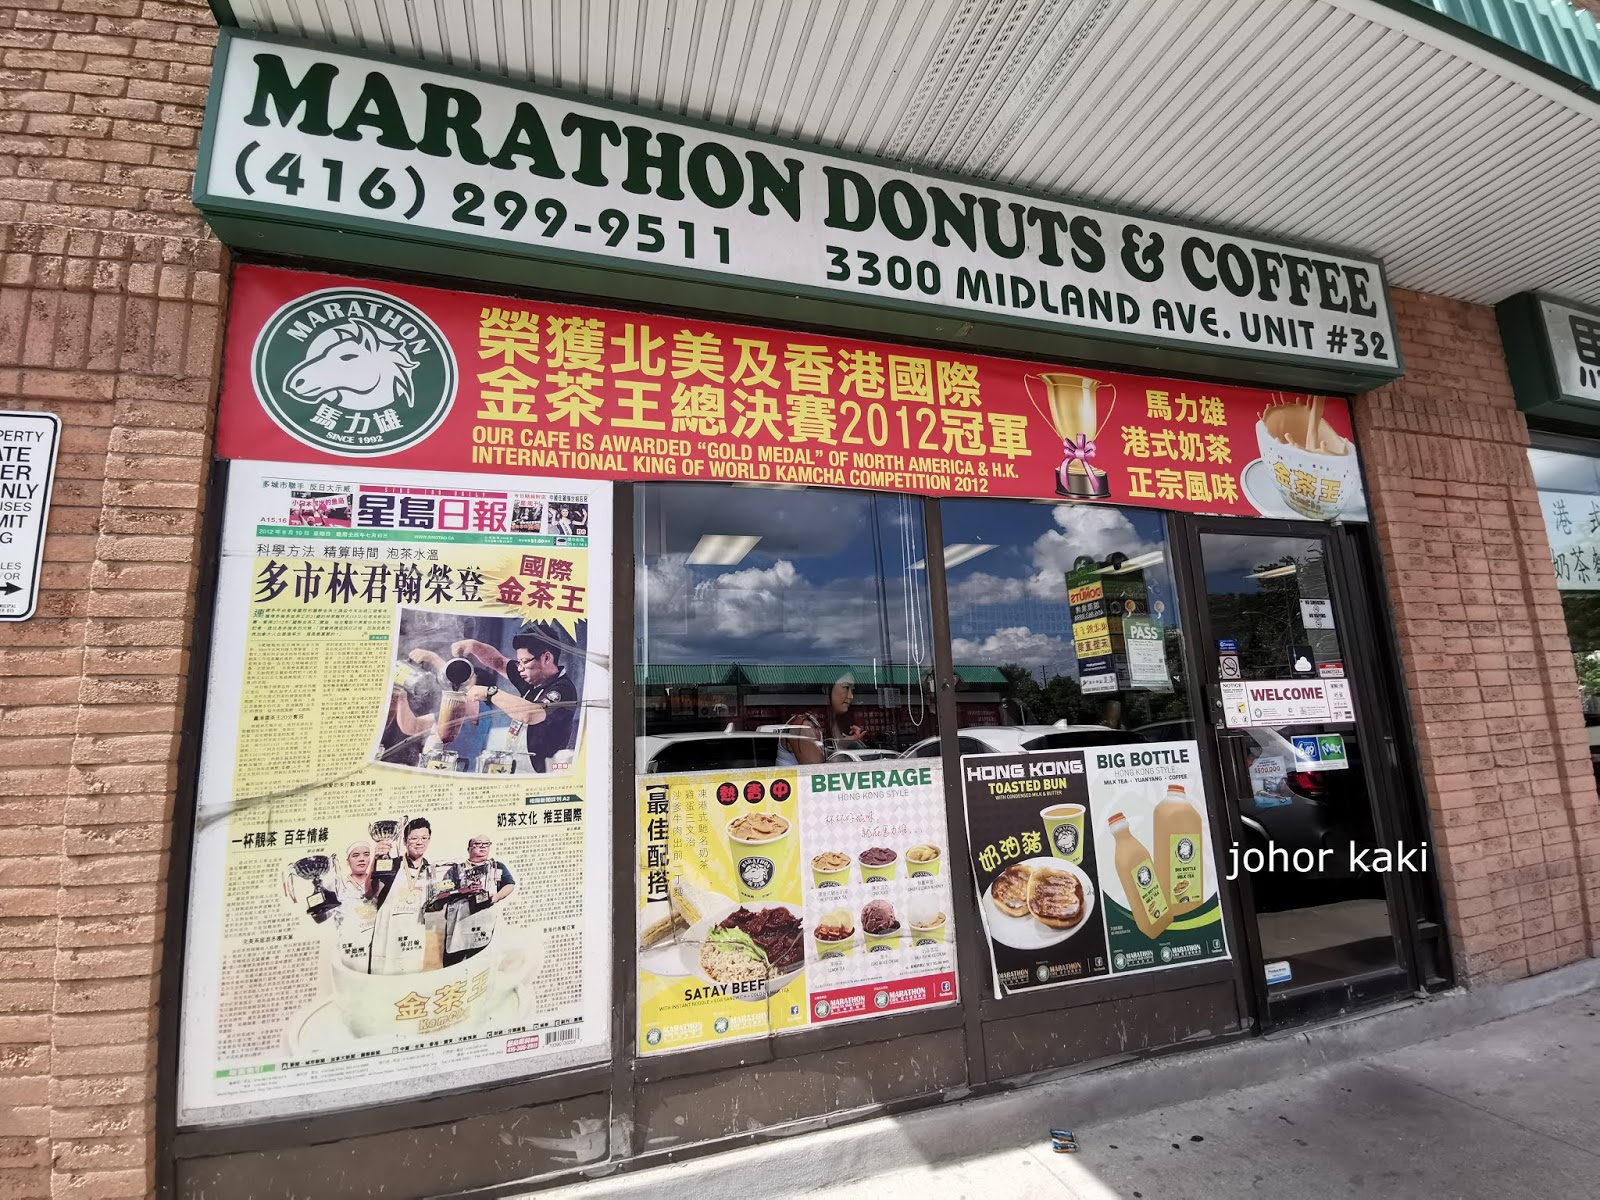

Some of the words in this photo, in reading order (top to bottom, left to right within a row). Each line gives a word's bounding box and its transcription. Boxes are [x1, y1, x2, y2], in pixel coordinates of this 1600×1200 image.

[243, 53, 804, 222] MARATHON
[822, 166, 1105, 273] DONUTS
[1121, 225, 1165, 282] &
[1181, 236, 1378, 318] COFFEE
[235, 141, 425, 220] (416)
[452, 183, 730, 265] 299-9511
[826, 245, 941, 296] 3300
[956, 267, 1140, 325] MIDLAND
[1153, 298, 1231, 340] AVE.
[1240, 313, 1314, 350] UNIT
[1327, 325, 1388, 360] #32
[286, 301, 430, 355] MARATHON
[478, 307, 981, 408] 榮獲北美及香港國際
[309, 403, 404, 435] 馬力雄
[477, 365, 1032, 461] 金茶王總決賽2012冠軍
[1146, 389, 1228, 426] 馬力雄
[326, 431, 355, 444] SINCE
[358, 434, 384, 444] 1992
[472, 425, 514, 445] OUR
[520, 428, 570, 449] CAFE
[576, 432, 594, 450] IS
[600, 435, 691, 456] AWARDED
[828, 451, 848, 467] OF
[853, 452, 904, 471] NORTH
[908, 456, 973, 475] AMERICA
[977, 462, 989, 477] &
[992, 463, 1019, 478] H.K.
[1120, 425, 1232, 465] 港式奶茶
[0, 446, 32, 462] TE
[472, 446, 627, 472] INTERNATIONAL
[633, 456, 676, 475] KING
[681, 458, 704, 477] OF
[709, 461, 770, 481] WORLD
[776, 465, 845, 484] KAMCHA
[849, 470, 951, 490] COMPETITION
[954, 477, 988, 493] 2012
[1273, 461, 1341, 503] 金茶王
[1128, 466, 1239, 505] 正宗風味
[357, 494, 507, 532] 星島日報
[257, 543, 315, 558] 科學方法
[323, 545, 379, 560] 精算時間
[386, 547, 439, 561] 泡茶水溫
[254, 559, 485, 605] 多市林君翰榮登
[519, 553, 574, 582] 國際
[496, 575, 586, 614] 金茶王
[1130, 626, 1158, 640] PASS
[1250, 687, 1324, 702] WELCOME
[967, 763, 1025, 782] HONG
[1029, 759, 1085, 777] KONG
[1096, 754, 1125, 769] BIG
[1130, 749, 1190, 767] BOTTLE
[1114, 769, 1134, 777] HONG
[1156, 766, 1176, 774] STYLE
[811, 767, 932, 793] BEVERAGE
[987, 780, 1041, 795] TOASTED
[1043, 777, 1067, 790] BUN
[838, 793, 860, 802] HONG
[862, 791, 884, 800] KONG
[885, 789, 909, 798] STYLE
[497, 811, 538, 827] 奶茶文化
[543, 808, 583, 824] 推至國際
[232, 831, 278, 849] 一杯靚茶
[284, 827, 330, 846] 百年情緣
[394, 967, 491, 1021] 金茶王
[684, 984, 728, 1001] SATAY
[732, 979, 766, 994] BEEF
[830, 995, 865, 1005] MARATHON
[889, 987, 926, 998] MARATHON
